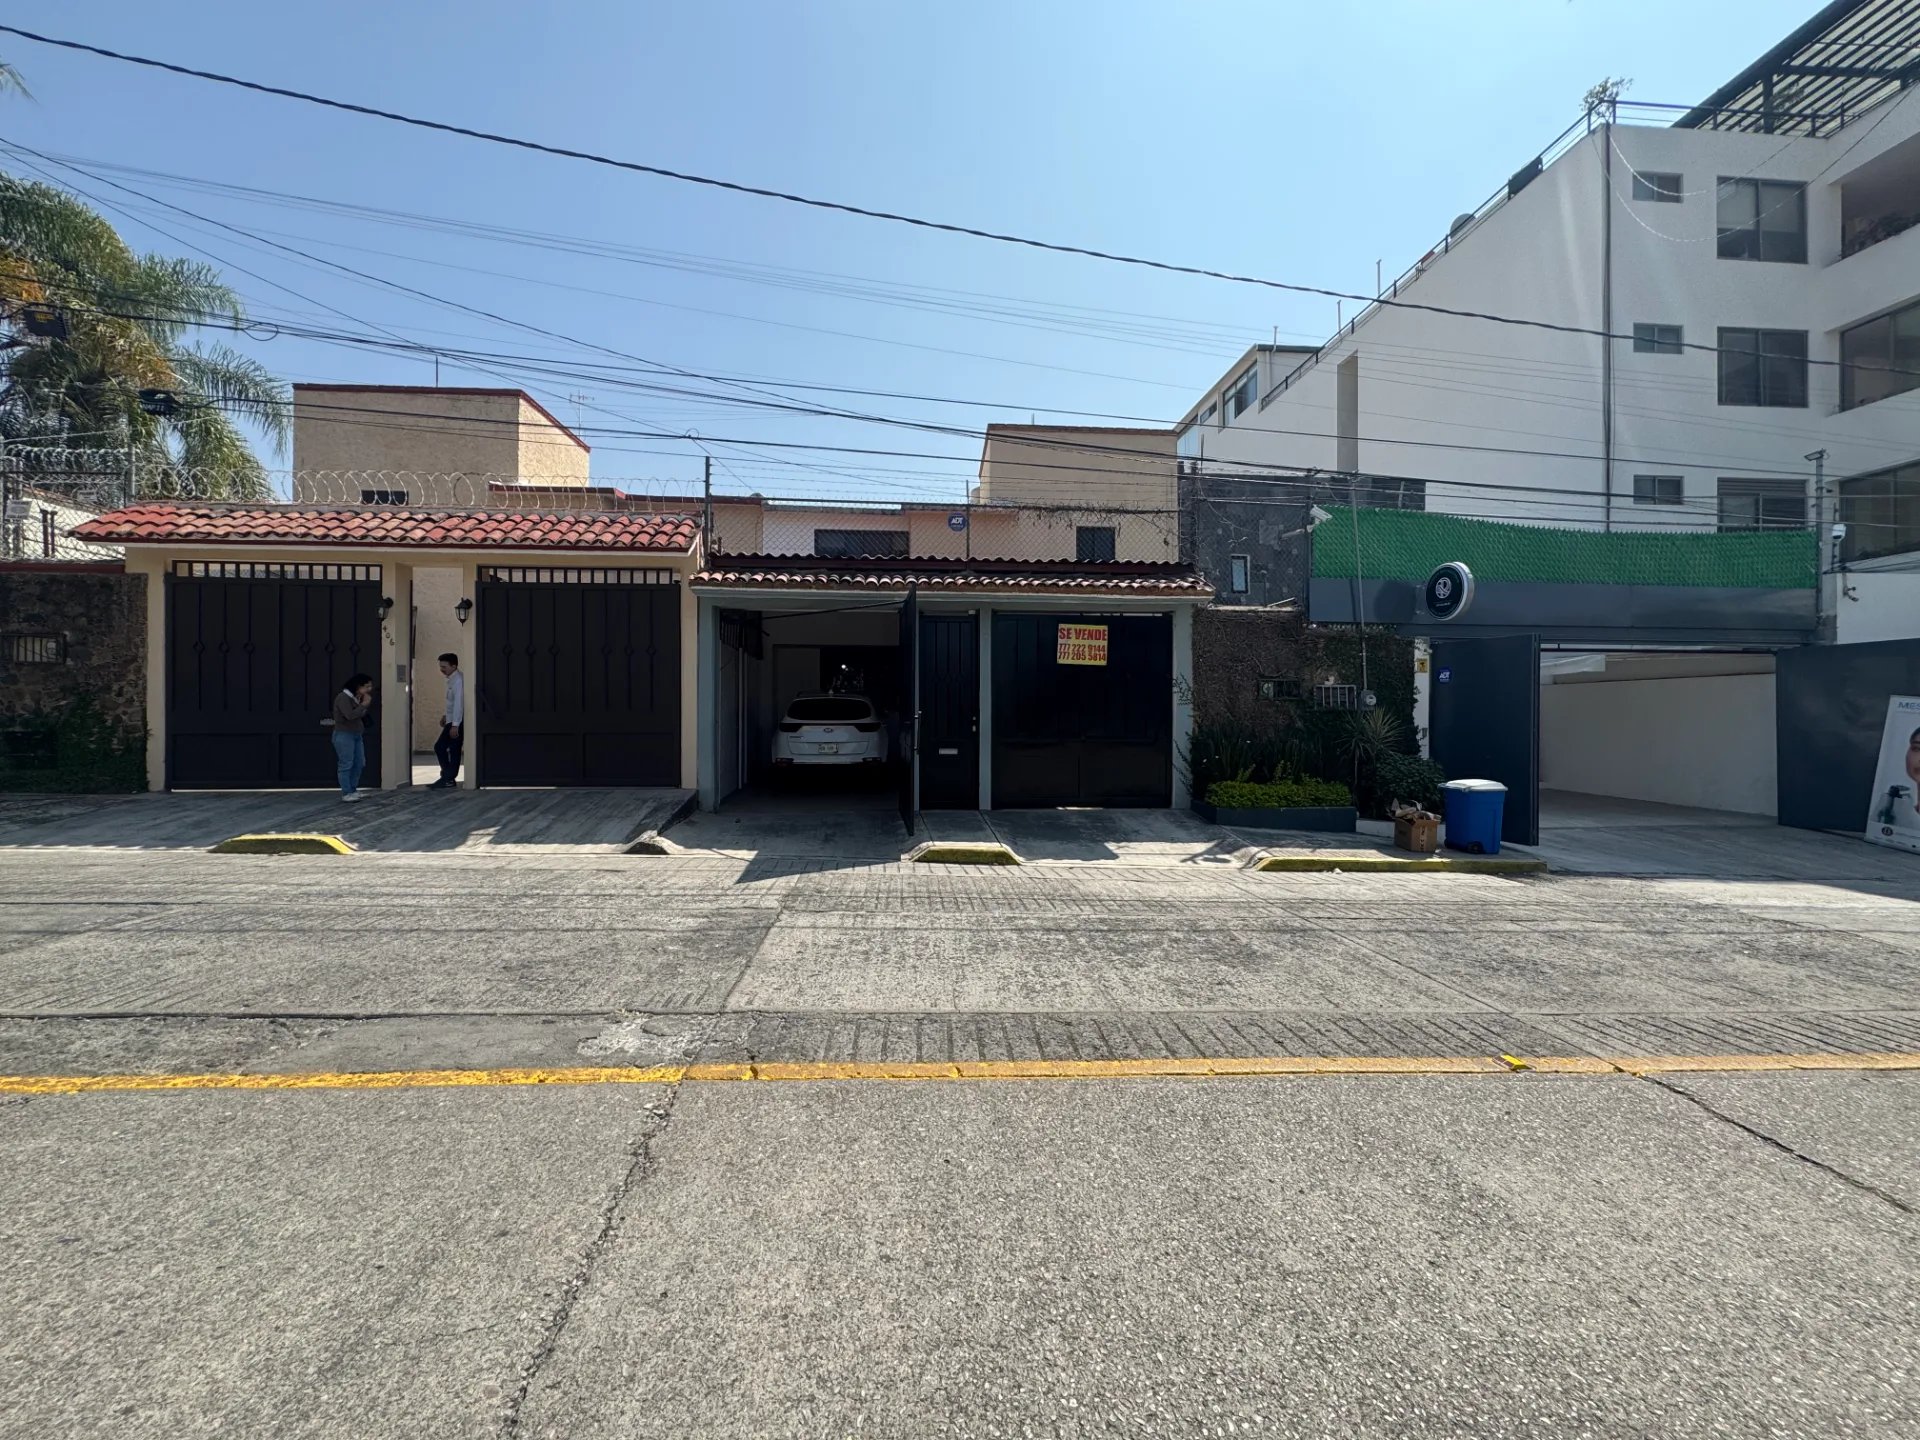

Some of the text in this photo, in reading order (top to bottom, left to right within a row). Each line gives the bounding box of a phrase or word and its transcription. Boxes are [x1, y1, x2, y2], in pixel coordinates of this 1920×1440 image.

[951, 517, 964, 525] ADT
[1059, 627, 1107, 641] SE VENDE
[1059, 643, 1071, 652] 777
[1072, 643, 1086, 652] 222
[1058, 651, 1070, 660] 777
[1071, 651, 1087, 661] 205
[1438, 671, 1451, 679] ADT
